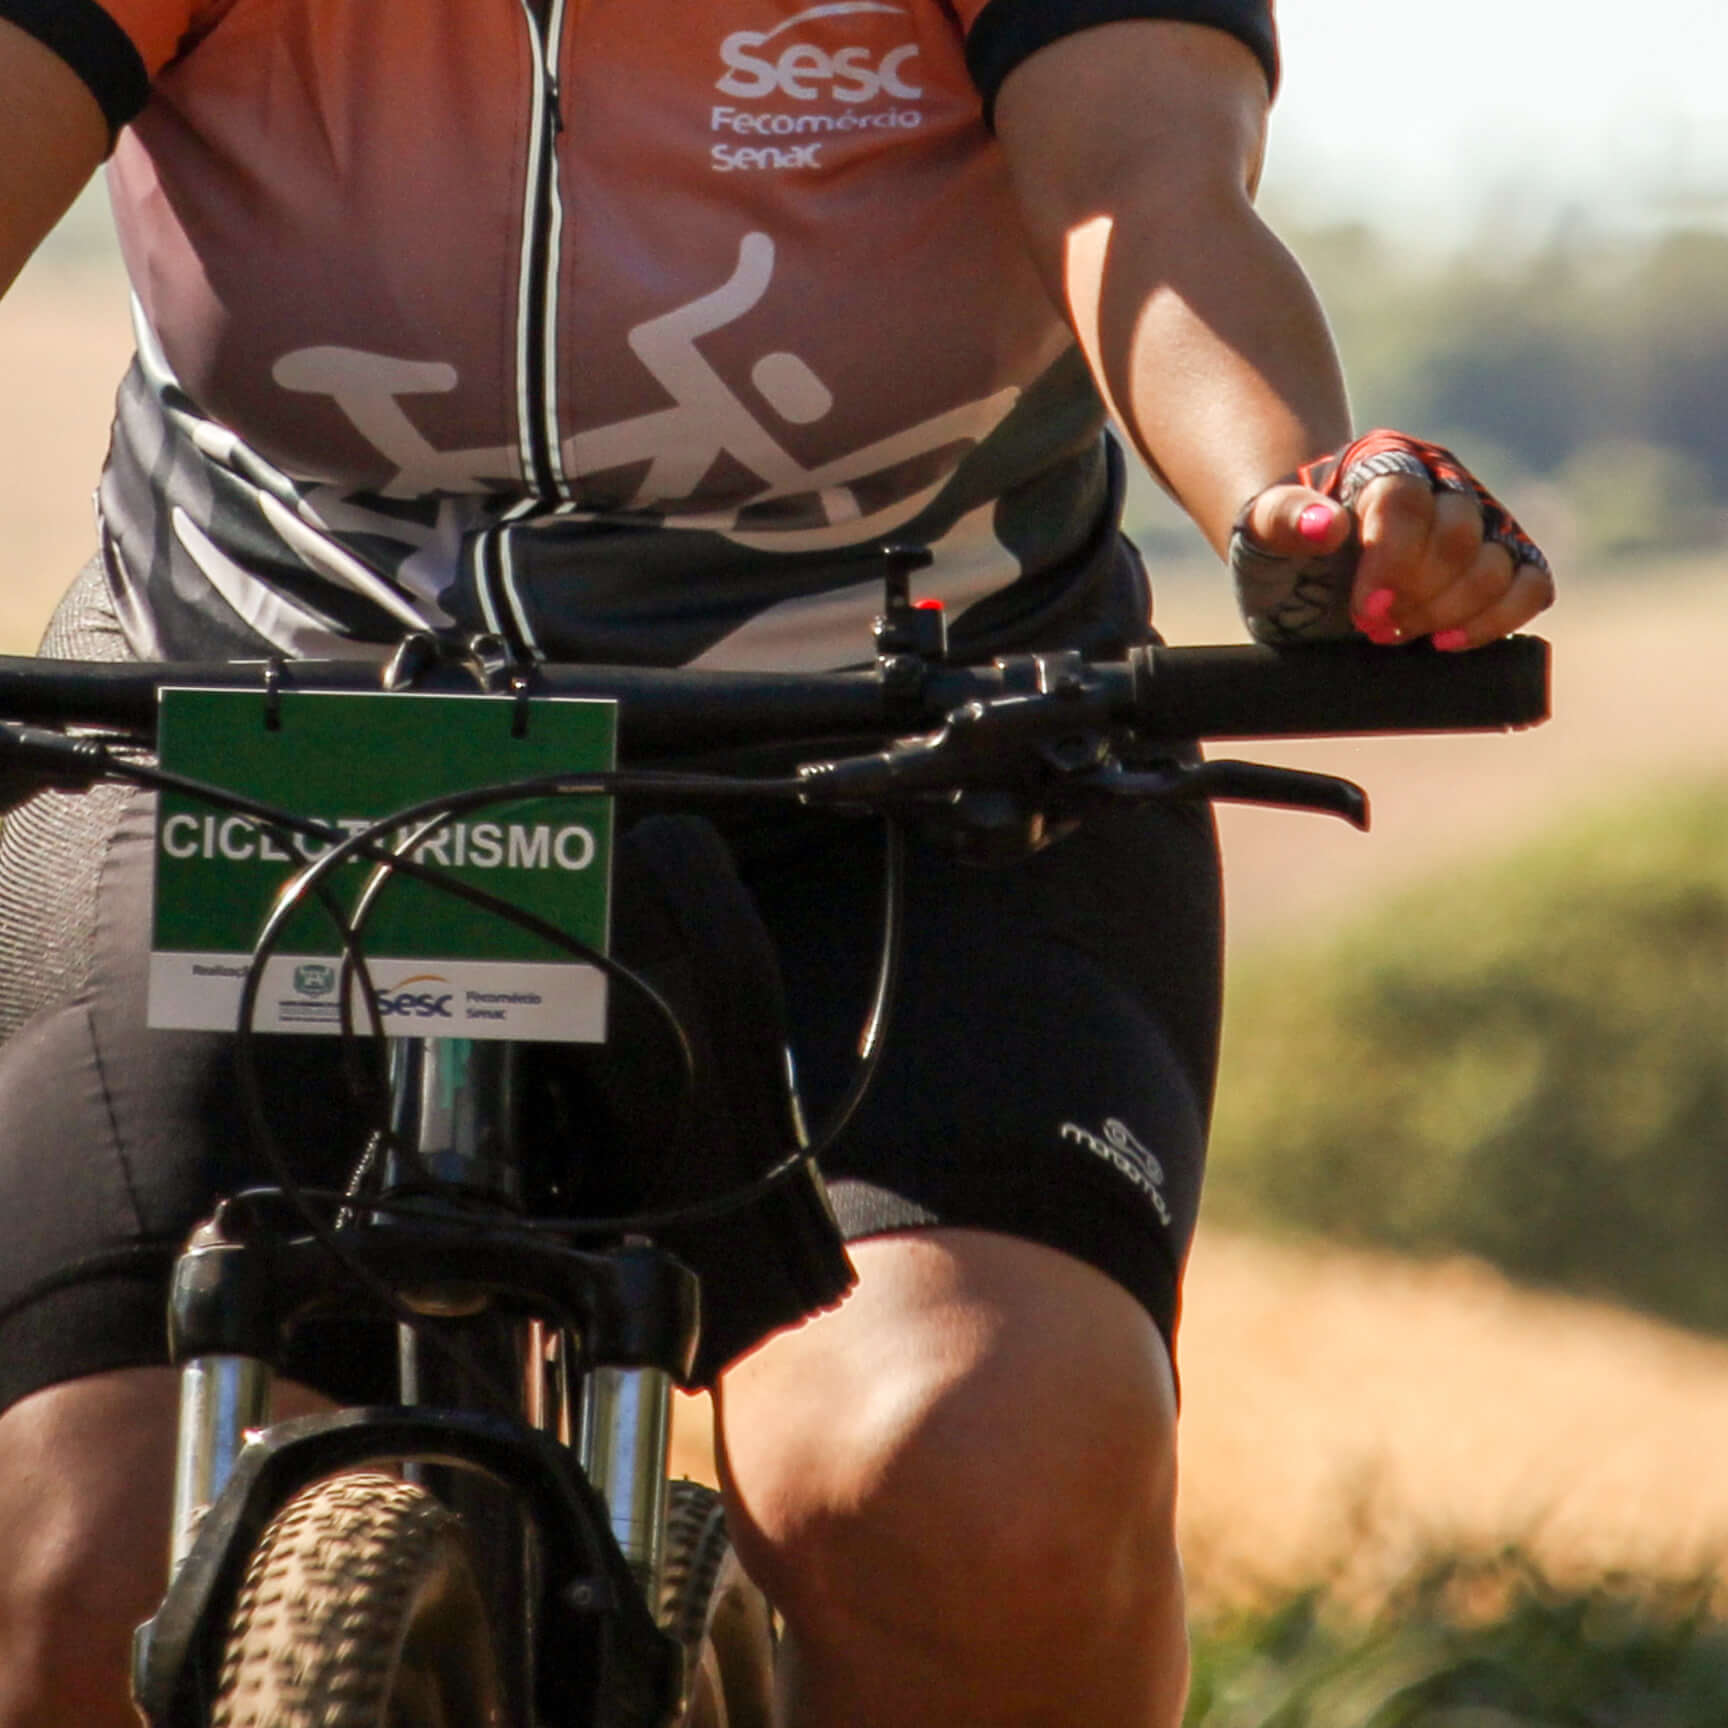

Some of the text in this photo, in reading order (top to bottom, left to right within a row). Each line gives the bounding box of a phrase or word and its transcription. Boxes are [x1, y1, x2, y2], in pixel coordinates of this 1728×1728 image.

[710, 105, 922, 135] Fecomércio
[710, 143, 822, 172] Senac
[162, 813, 596, 871] CICLOTRISMO
